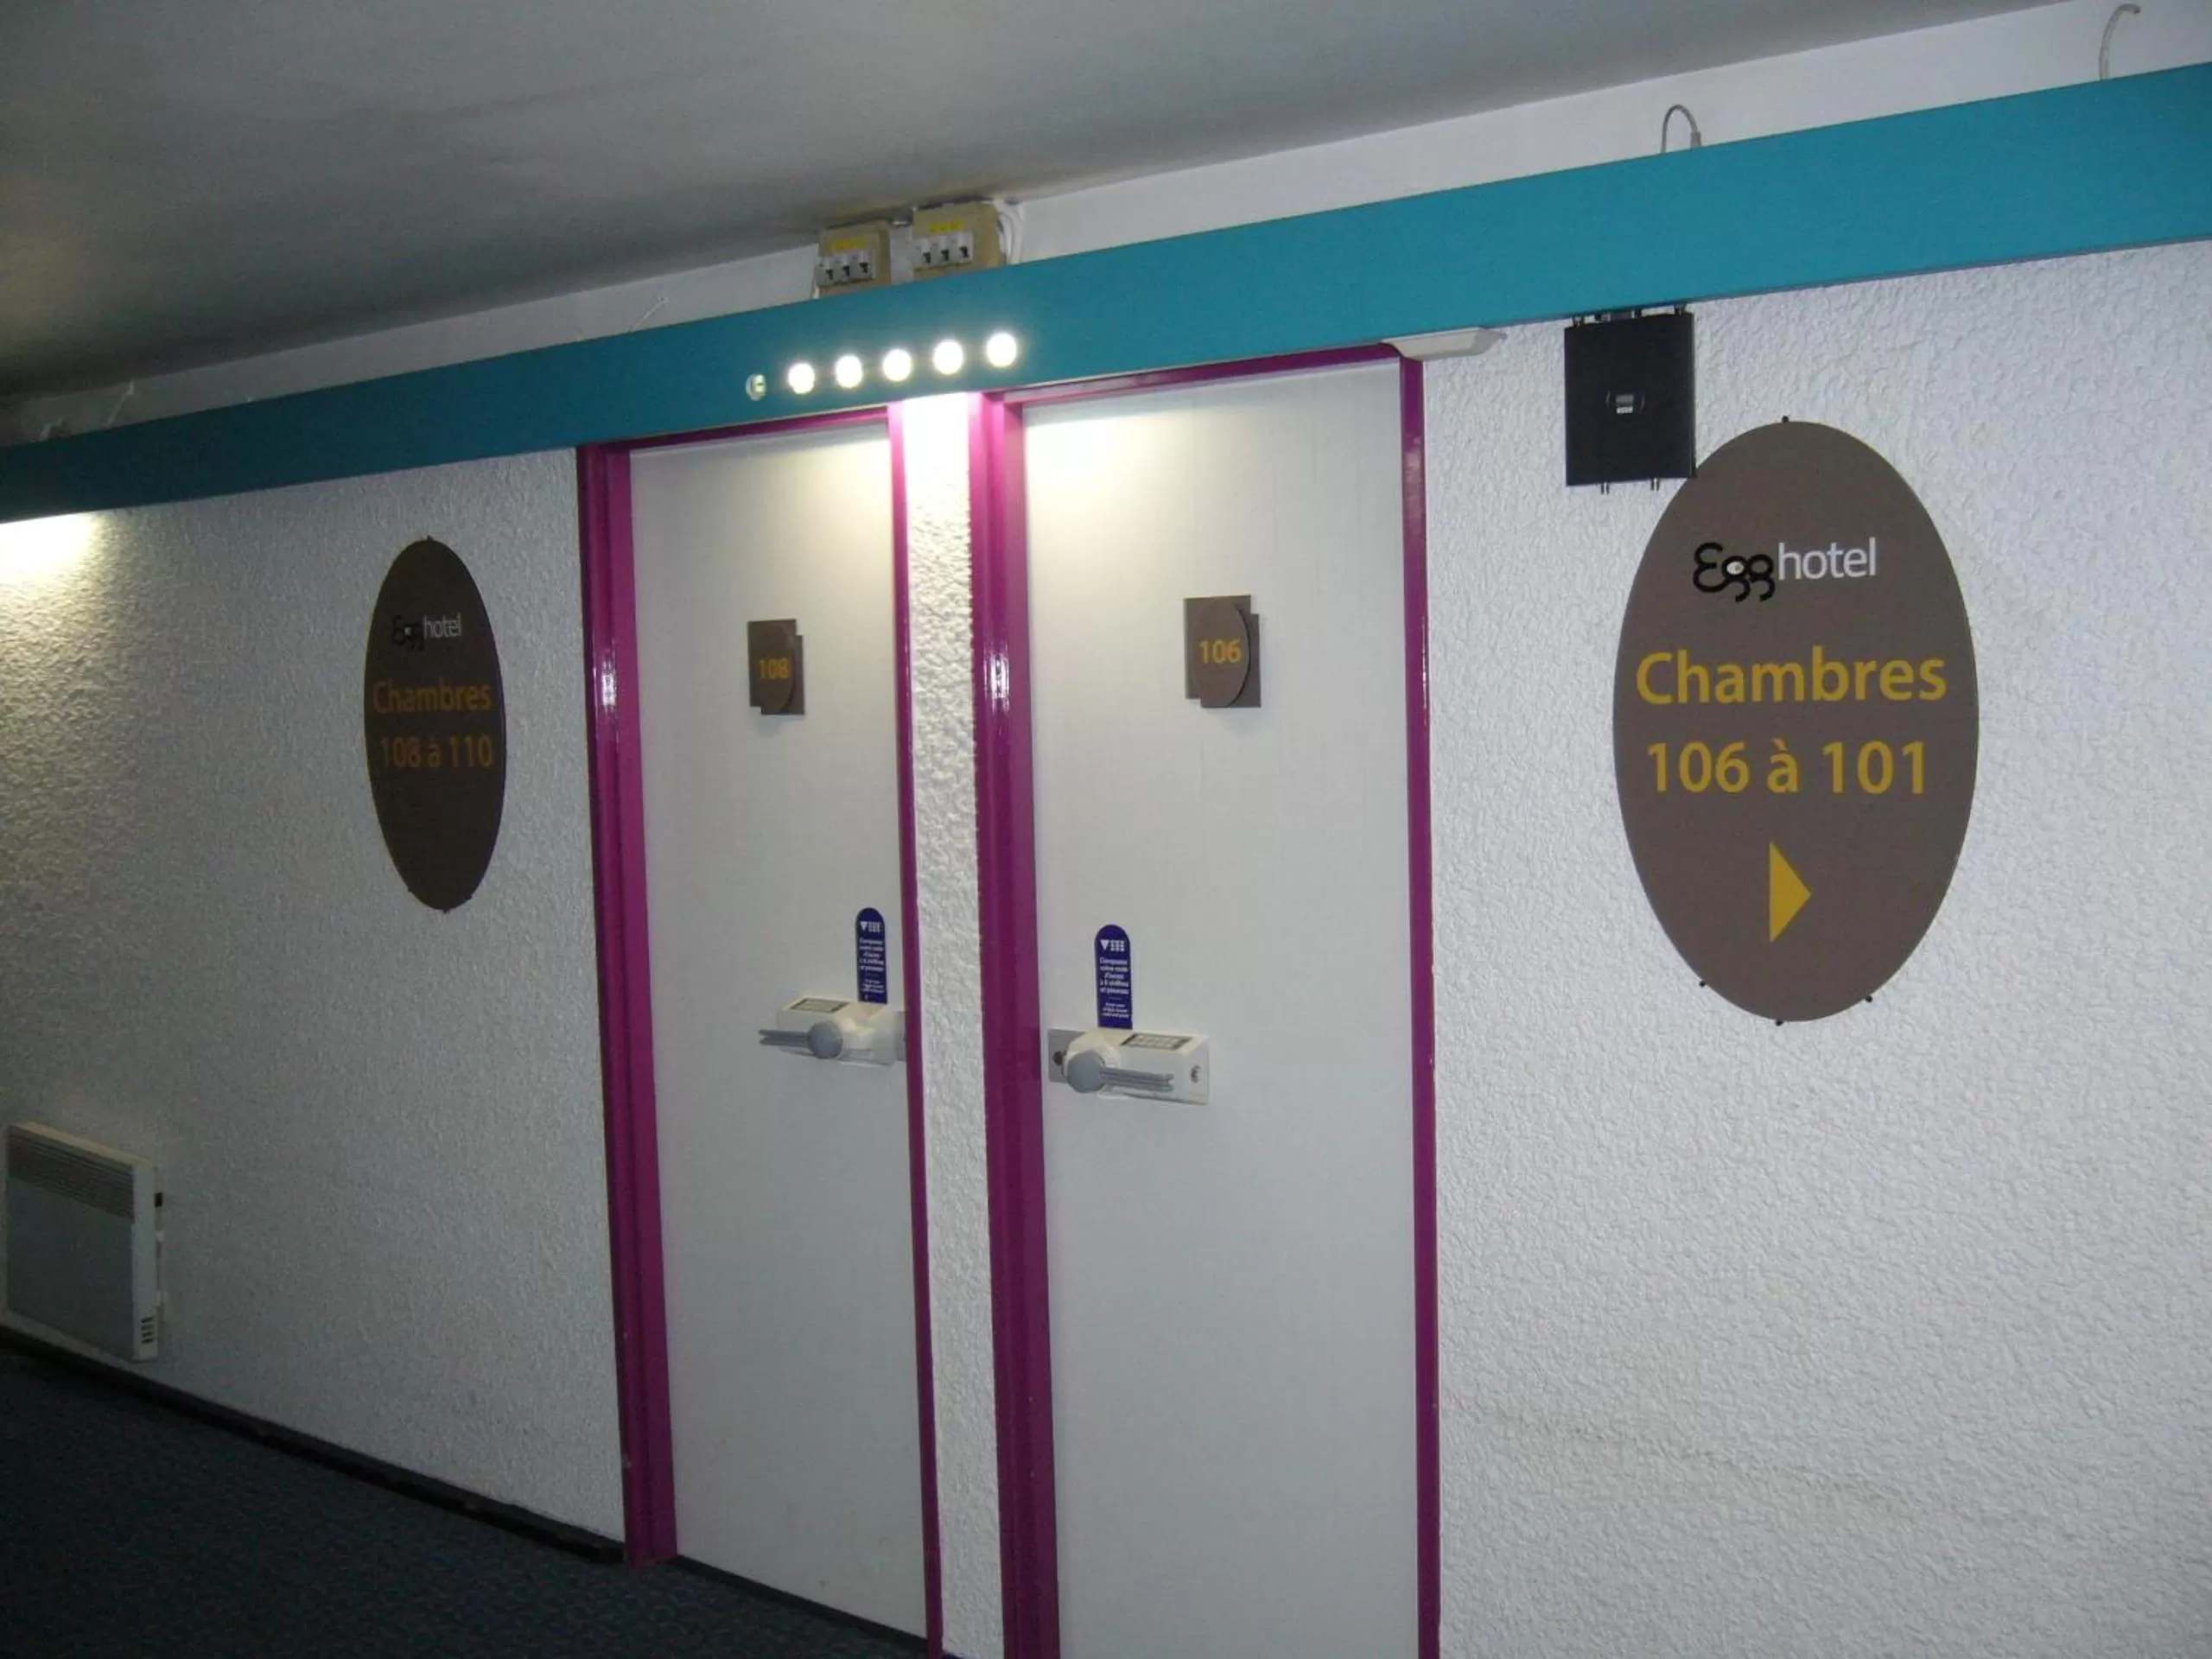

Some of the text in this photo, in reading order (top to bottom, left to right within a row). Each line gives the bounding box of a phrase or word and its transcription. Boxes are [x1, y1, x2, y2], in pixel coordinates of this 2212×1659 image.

[759, 658, 790, 679] 108
[1199, 639, 1241, 664] 106
[1637, 645, 1947, 704] Chambres
[372, 678, 492, 714] Chambres
[380, 736, 422, 768] 108
[449, 734, 494, 767] 110
[1648, 739, 1925, 794] 106 à 101
